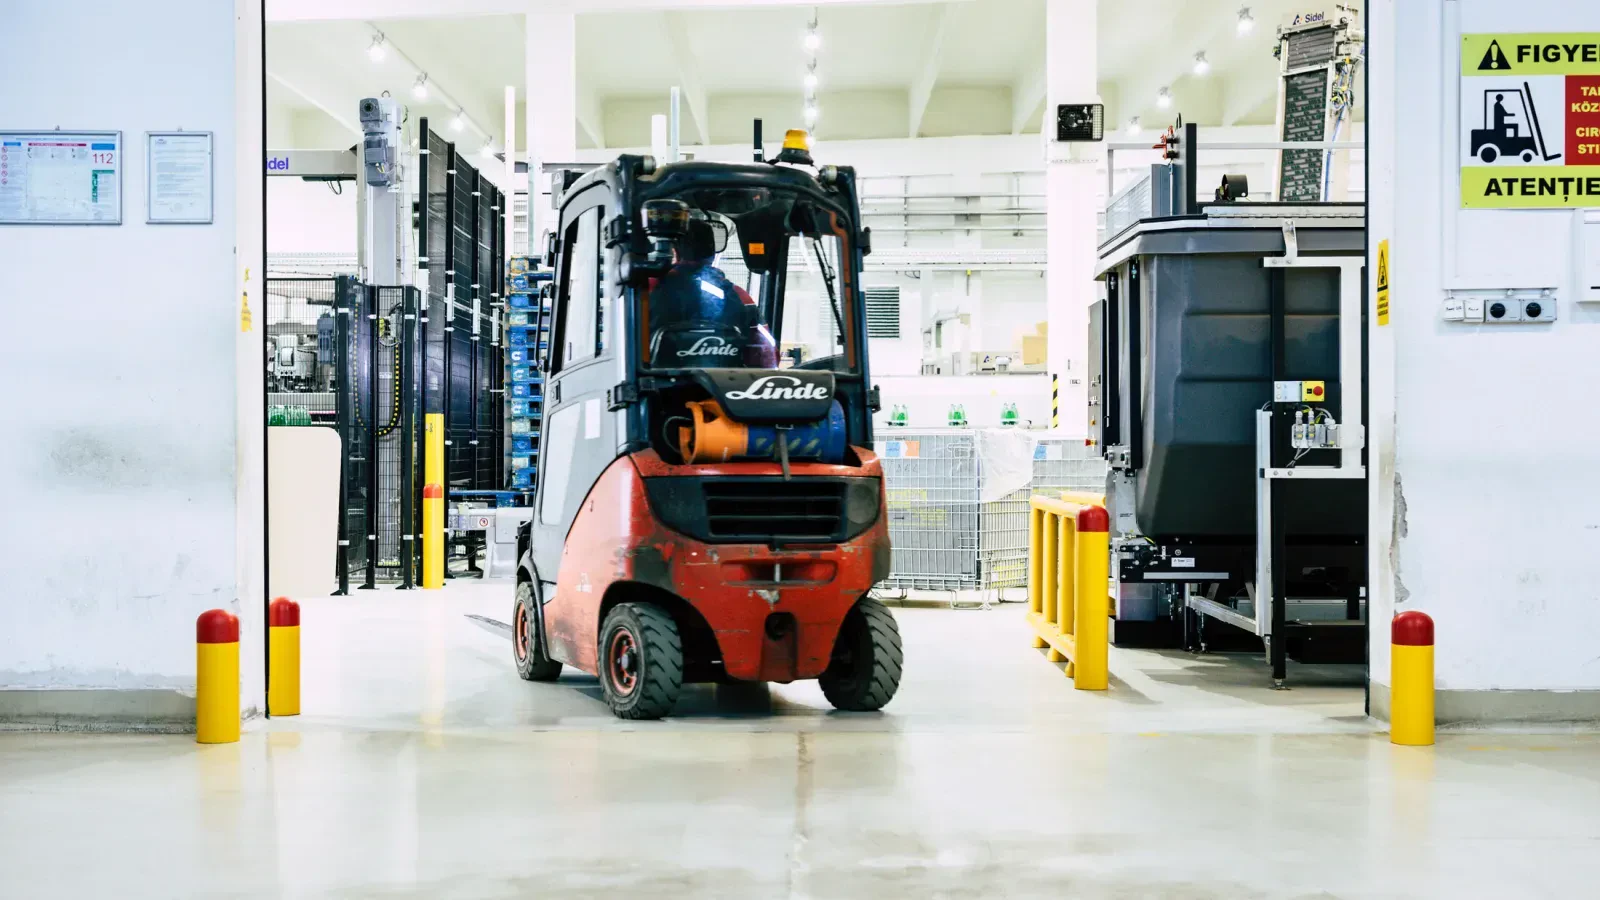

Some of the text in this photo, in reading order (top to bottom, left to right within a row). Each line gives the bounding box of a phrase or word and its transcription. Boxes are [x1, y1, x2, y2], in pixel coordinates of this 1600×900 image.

[1305, 11, 1325, 23] Sidel
[1517, 44, 1600, 63] FIGYE
[1581, 86, 1600, 96] TA
[1571, 100, 1600, 113] KÖZ
[1576, 127, 1600, 137] CIR
[1578, 143, 1600, 154] STI
[93, 153, 114, 164] 112
[265, 157, 289, 170] idel
[1484, 177, 1600, 202] ATENȚIE
[676, 336, 739, 356] Linde
[725, 375, 829, 400] Linde
